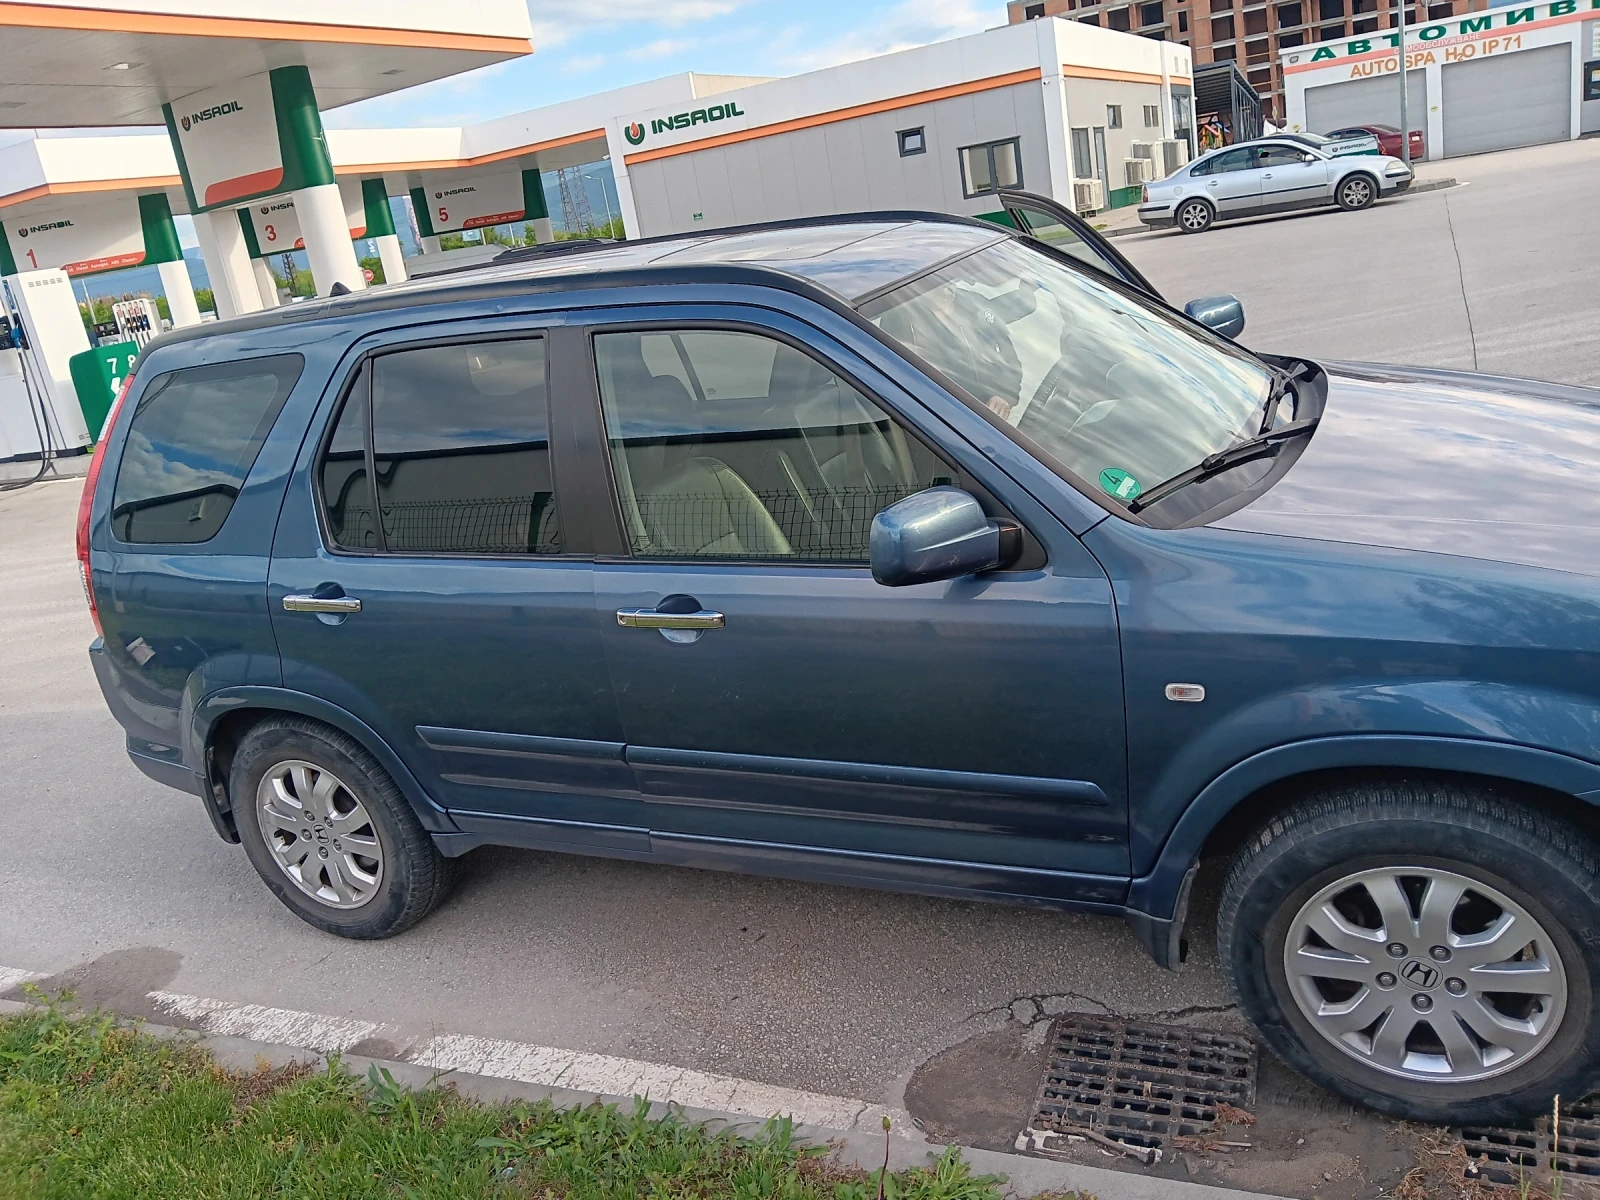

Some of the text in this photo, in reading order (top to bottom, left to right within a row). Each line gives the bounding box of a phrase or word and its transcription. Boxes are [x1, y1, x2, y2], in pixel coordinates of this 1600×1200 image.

[1393, 33, 1481, 55] СМООБСЛУЖВАНЕ
[1350, 58, 1398, 78] AUTO
[1405, 51, 1436, 68] SPA
[1482, 40, 1499, 54] IP
[1503, 35, 1521, 51] 71
[192, 101, 243, 124] INSAOIL
[651, 102, 744, 134] INSAOIL
[443, 187, 477, 196] INSAOIL
[270, 202, 294, 211] INSA
[438, 207, 449, 222] 5
[30, 220, 74, 233] INSAOIL
[264, 224, 277, 241] 3
[26, 248, 38, 269] 1
[106, 357, 118, 374] 7
